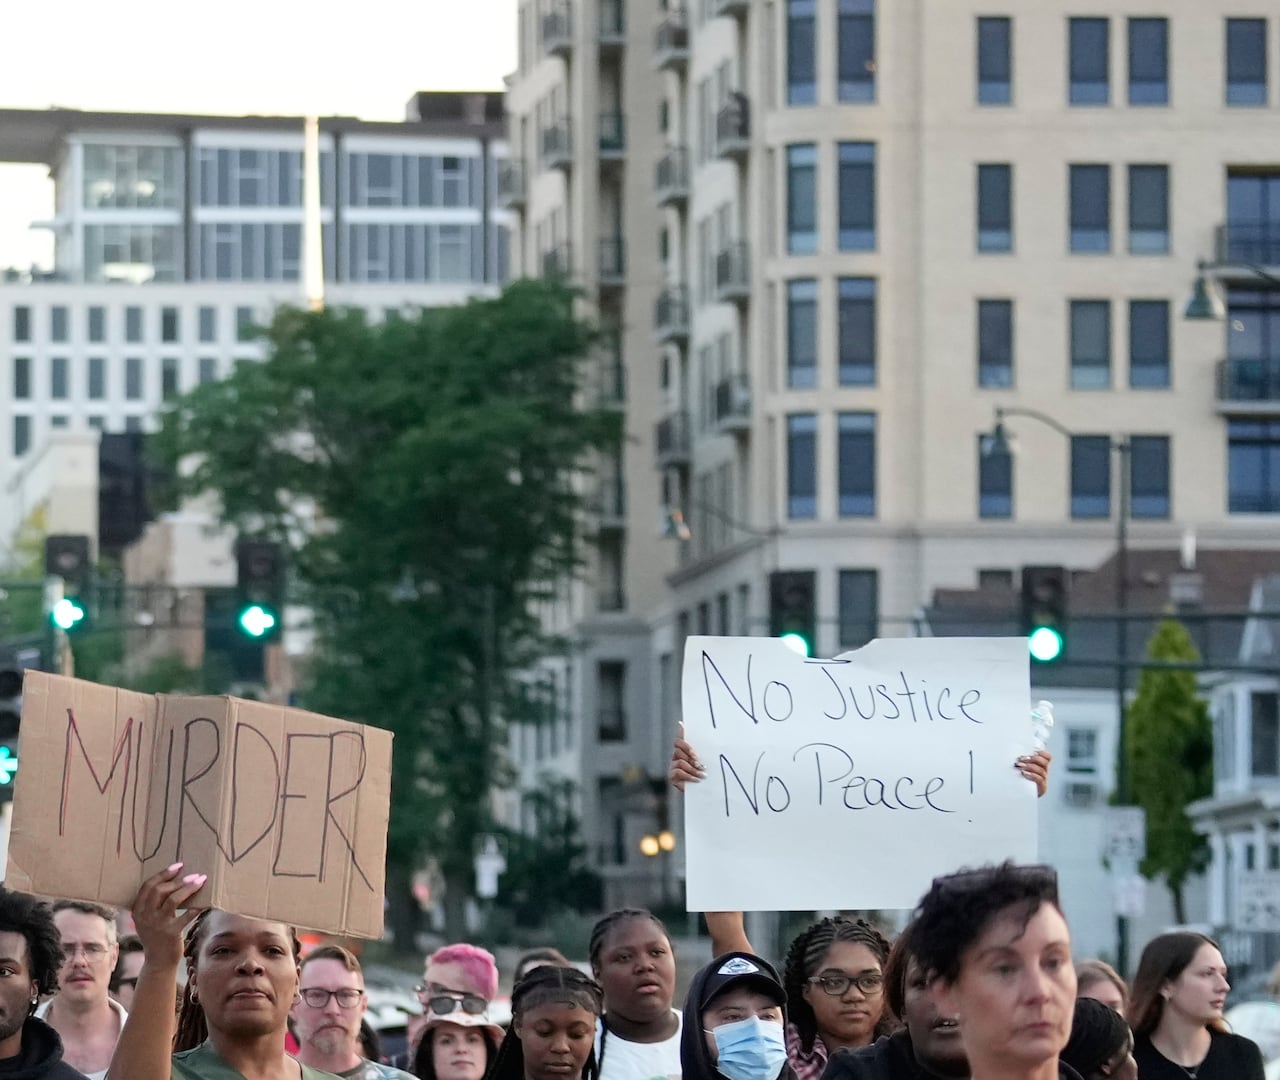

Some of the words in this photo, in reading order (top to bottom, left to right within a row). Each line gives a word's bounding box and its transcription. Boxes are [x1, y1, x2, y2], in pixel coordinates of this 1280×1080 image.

[701, 649, 794, 728] No
[803, 656, 985, 724] Justice
[58, 707, 374, 892] MURDER
[719, 750, 791, 818] No
